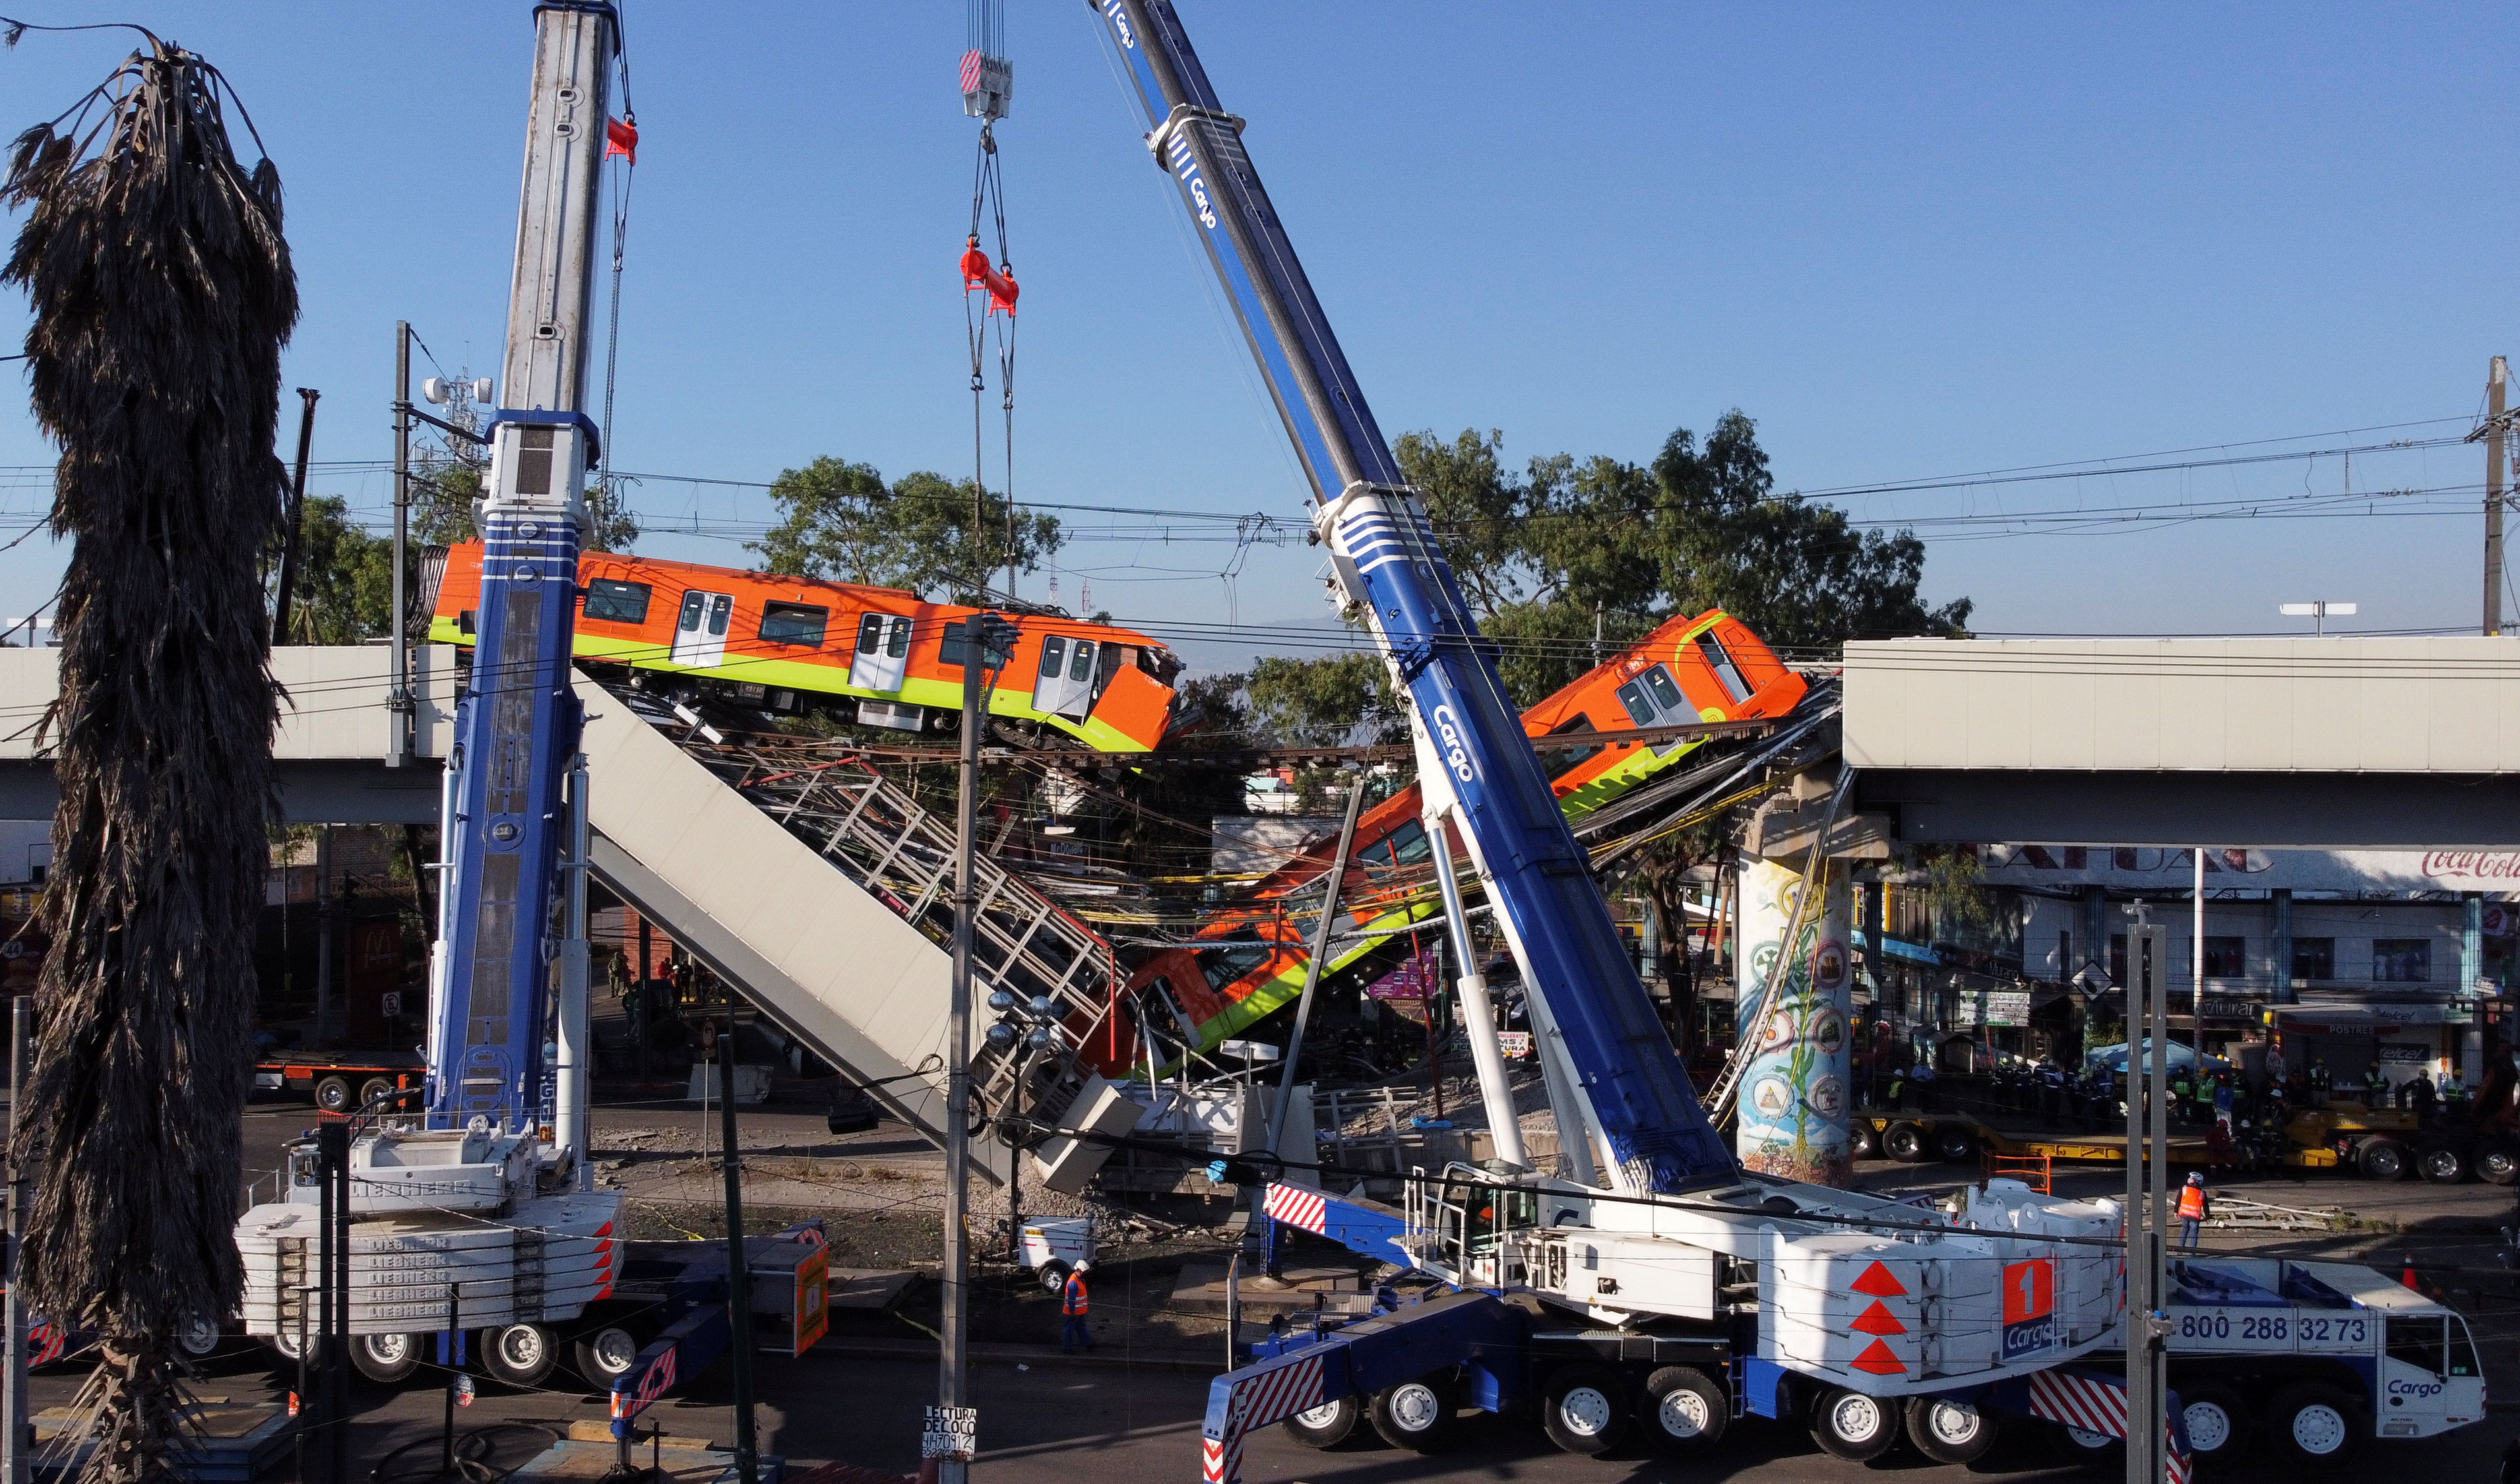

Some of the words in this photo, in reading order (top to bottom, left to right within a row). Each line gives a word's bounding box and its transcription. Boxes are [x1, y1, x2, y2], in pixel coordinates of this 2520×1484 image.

[1116, 13, 1134, 49] Cargo
[1191, 177, 1216, 229] Cargo
[1616, 655, 1645, 678] CDMX
[1433, 704, 1473, 782] Cargo
[1988, 961, 2019, 981] Murano
[2329, 1025, 2376, 1035] POSTRES
[349, 1178, 473, 1198] LIEBHERR
[368, 1237, 448, 1251] LIEBHERR
[368, 1254, 447, 1268] LIEBHERR
[368, 1270, 447, 1285] LIEBHERR
[368, 1287, 448, 1302] LIEBHERR
[2019, 1266, 2034, 1314] 1
[368, 1303, 447, 1318] LIEBHERR
[2007, 1322, 2054, 1349] Cargo
[2182, 1314, 2230, 1339] 800
[2242, 1316, 2288, 1340] 288
[2388, 1378, 2442, 1398] Cargo
[924, 1406, 976, 1420] LECTURA
